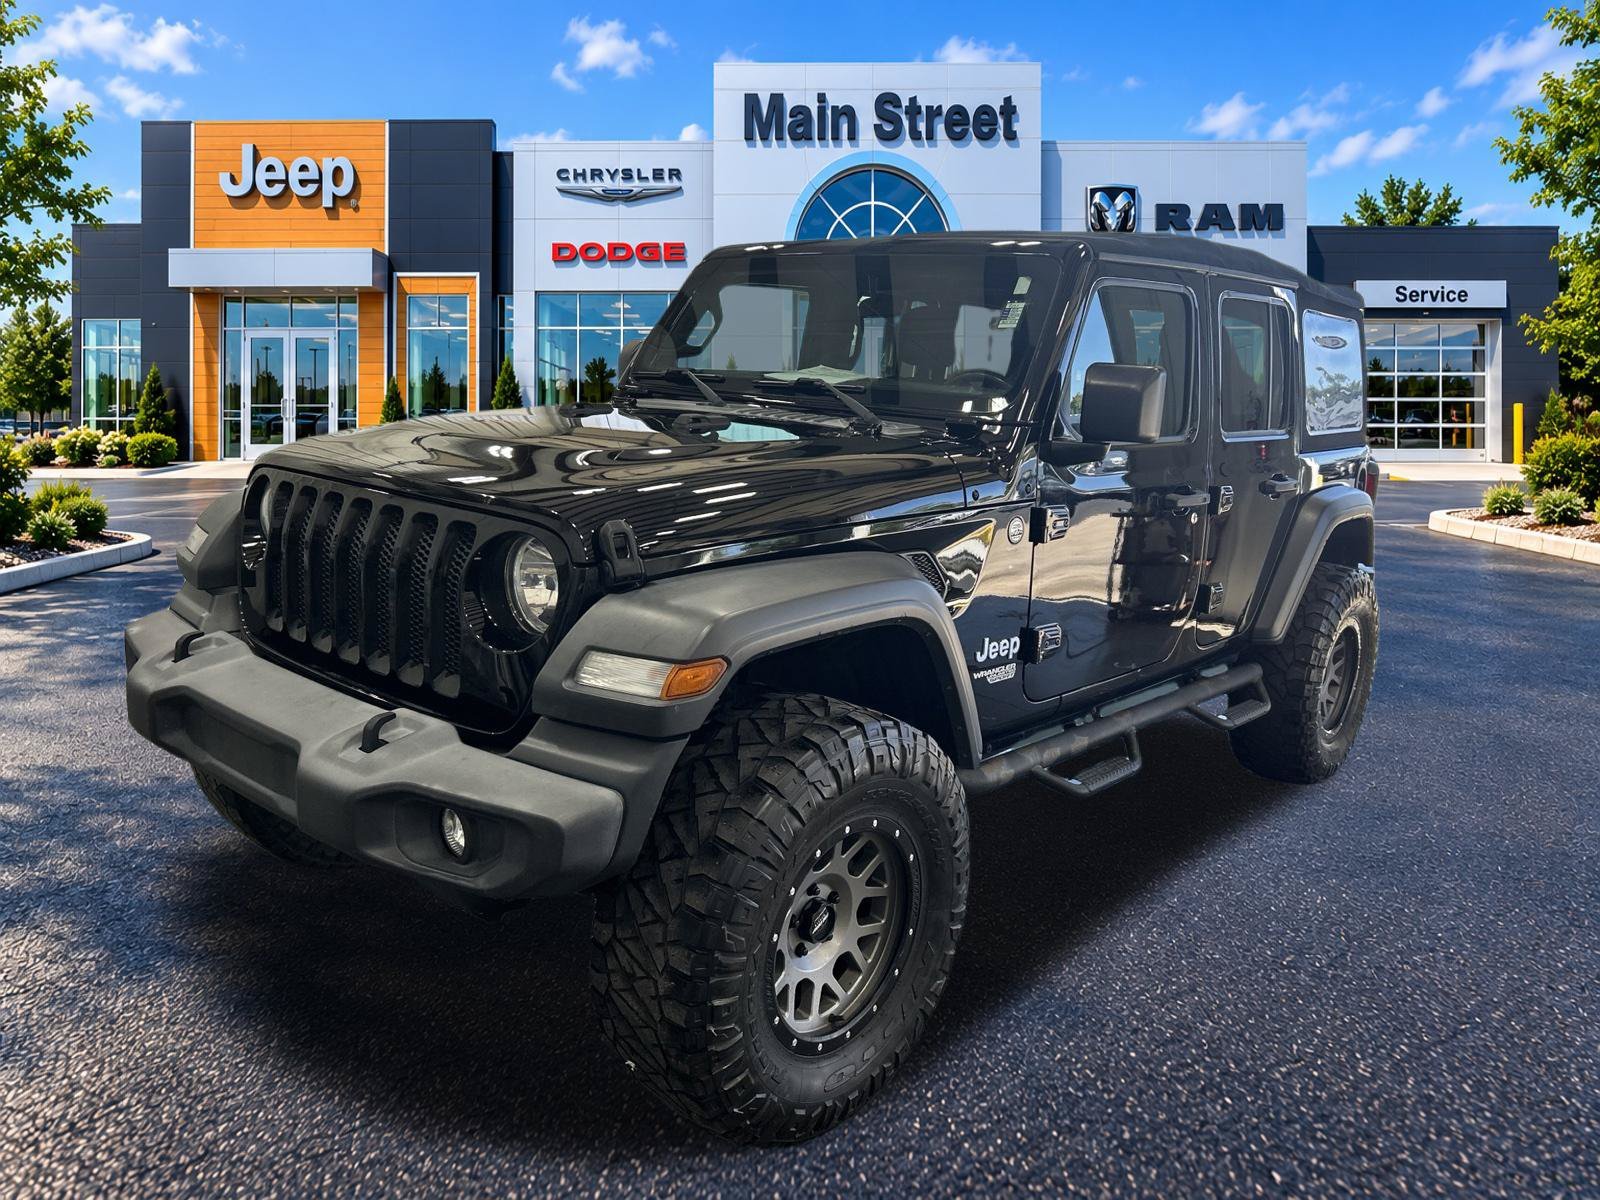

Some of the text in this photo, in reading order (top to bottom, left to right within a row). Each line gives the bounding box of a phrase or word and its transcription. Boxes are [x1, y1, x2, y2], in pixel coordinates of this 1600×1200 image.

[744, 92, 1019, 141] Main Street
[218, 143, 355, 208] Jeep
[556, 168, 682, 182] CHRYSLER
[1155, 203, 1284, 231] RAM
[551, 242, 687, 261] DODGE
[1395, 285, 1469, 303] Service
[976, 636, 1020, 662] Jeep
[973, 663, 1016, 679] WRANGLER
